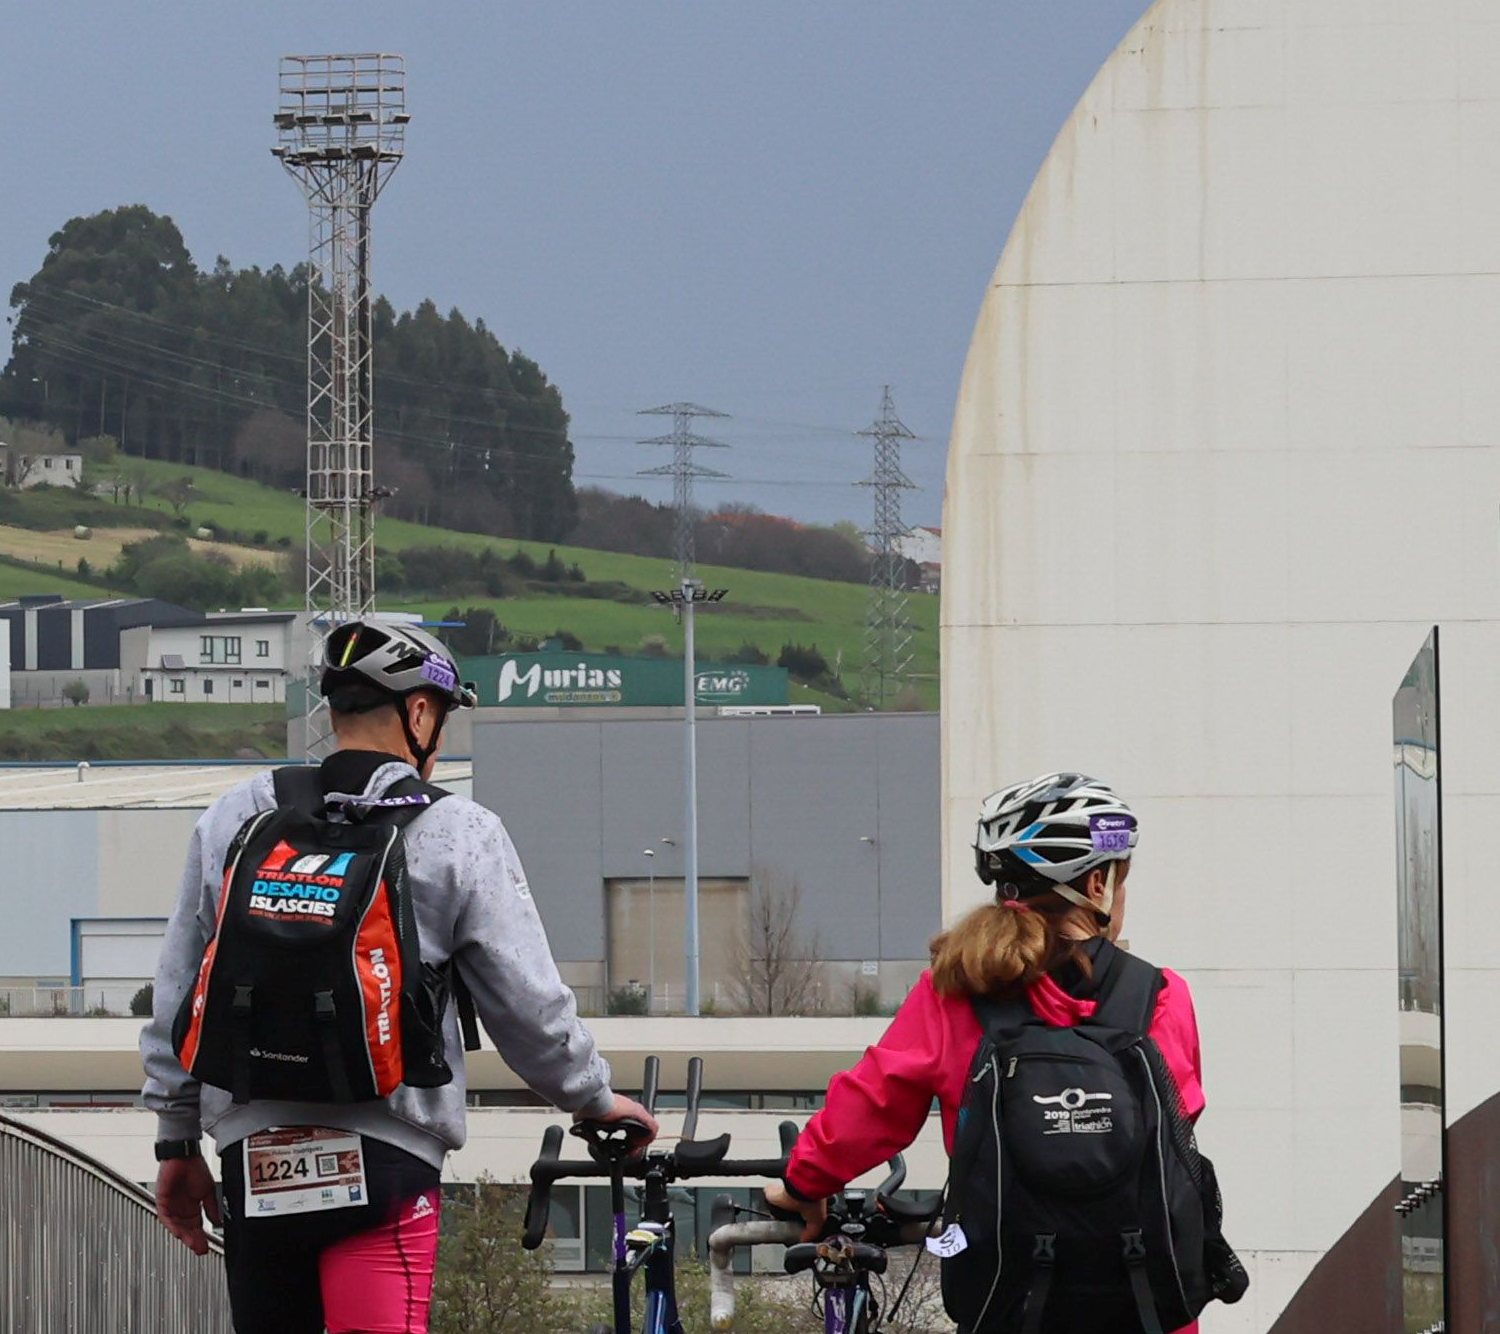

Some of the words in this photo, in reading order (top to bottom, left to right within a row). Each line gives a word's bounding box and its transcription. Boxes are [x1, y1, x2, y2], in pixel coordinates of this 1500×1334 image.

[427, 666, 452, 687] 1224
[498, 659, 622, 702] Murias
[698, 677, 742, 692] EMG
[249, 895, 337, 917] ISLASCIES
[262, 1050, 308, 1063] Santander
[1044, 1110, 1070, 1120] 2019
[254, 1158, 309, 1183] 1224
